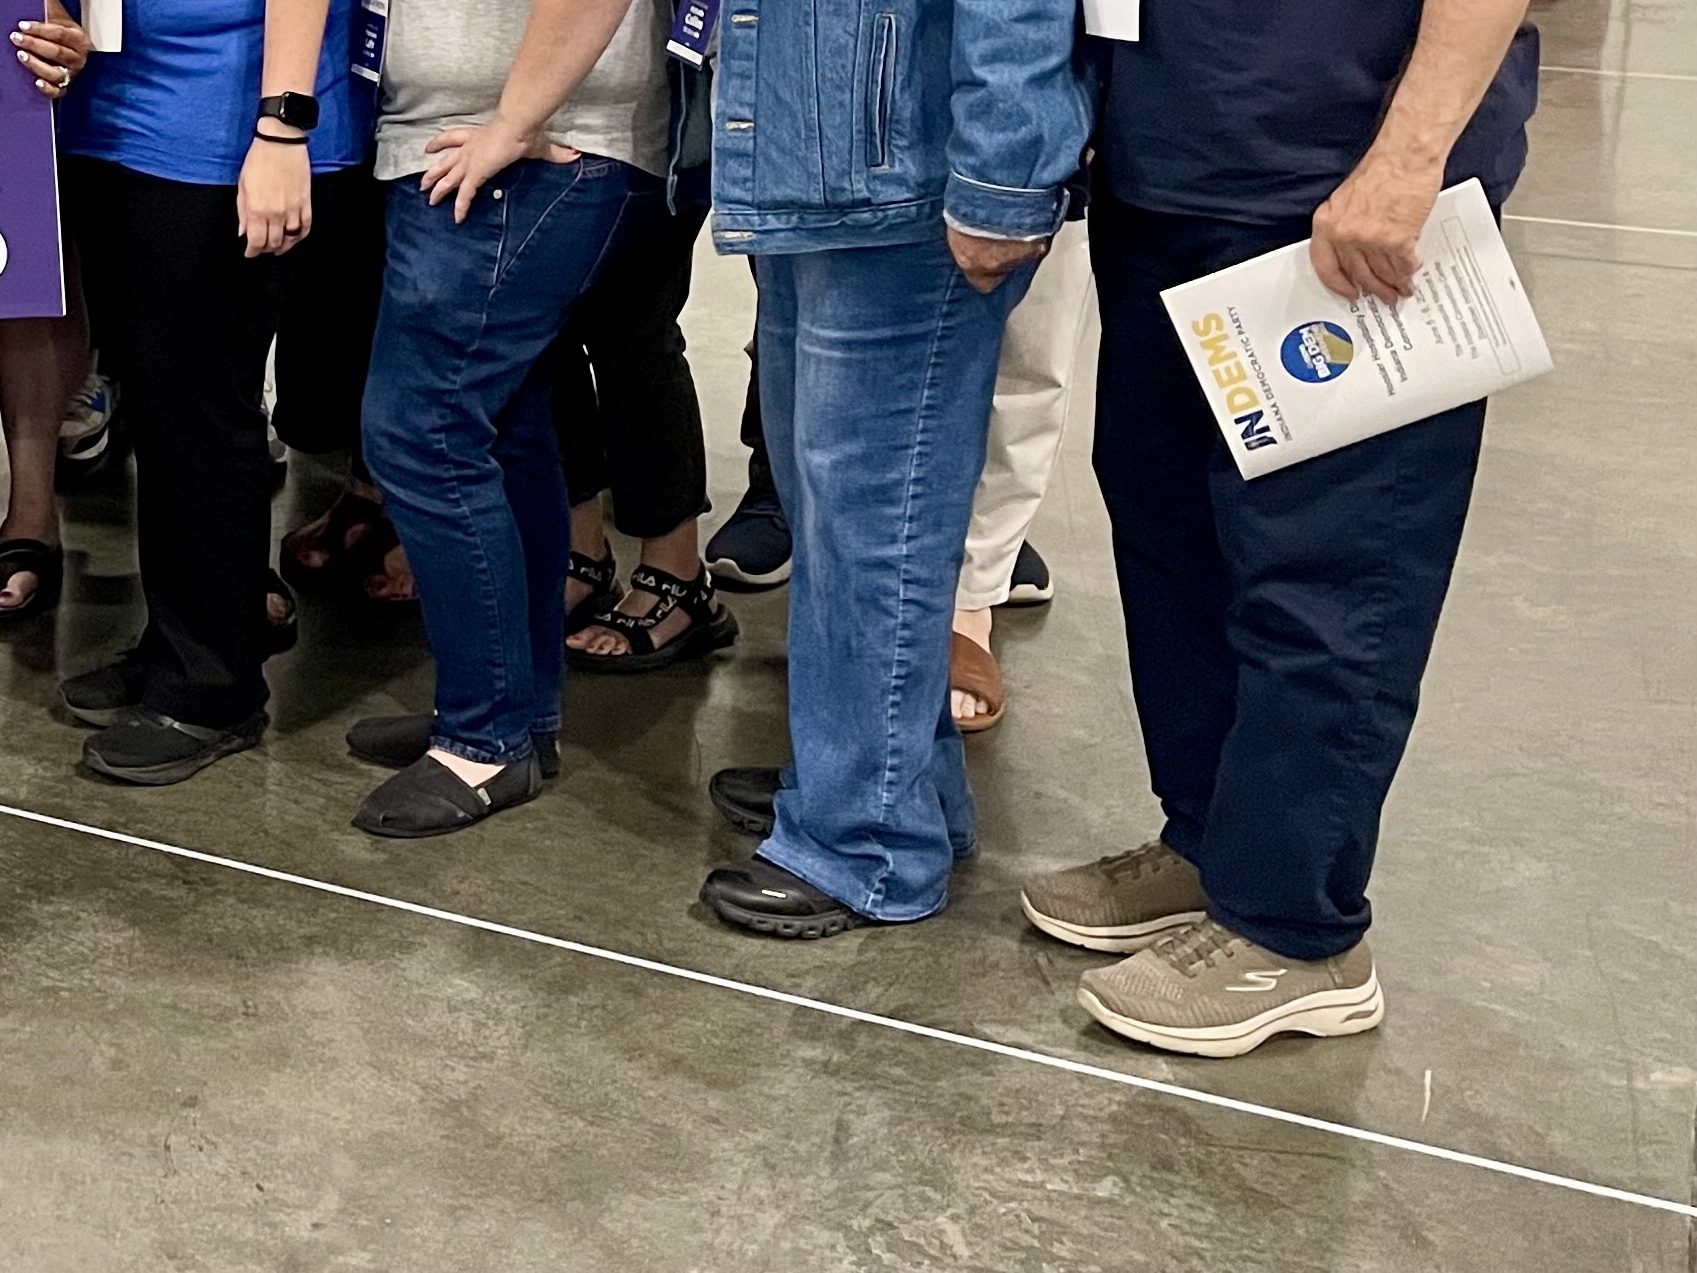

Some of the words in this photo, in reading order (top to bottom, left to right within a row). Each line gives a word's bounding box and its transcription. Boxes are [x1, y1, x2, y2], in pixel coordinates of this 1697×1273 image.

[1226, 305, 1247, 336] PARTY
[1191, 312, 1278, 451] INDEMS
[1241, 338, 1275, 401] DEMOCRATIC
[1271, 401, 1293, 442] INDIANA
